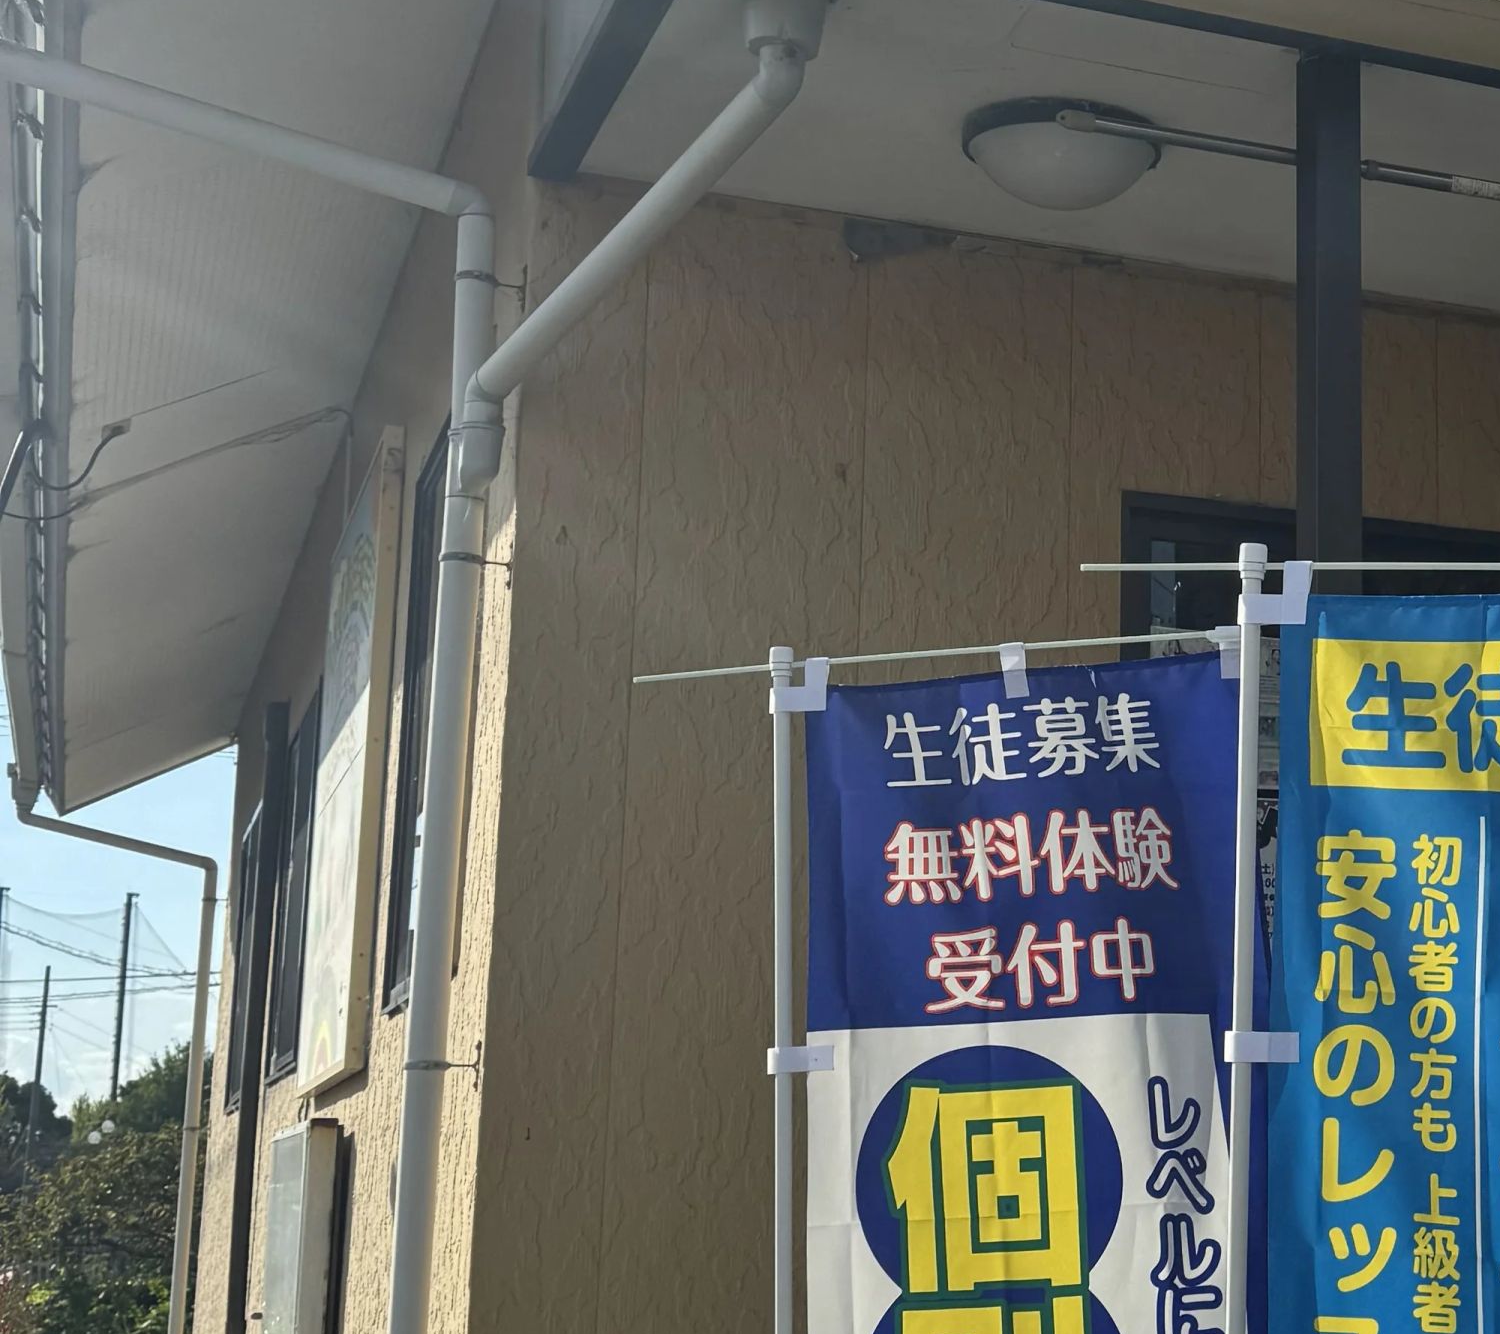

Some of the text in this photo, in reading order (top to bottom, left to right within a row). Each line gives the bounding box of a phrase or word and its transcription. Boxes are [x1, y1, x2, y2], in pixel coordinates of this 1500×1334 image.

[883, 693, 1160, 787] 生徒募集
[883, 807, 1180, 906] 無料体験
[924, 916, 1155, 1013] 受付中
